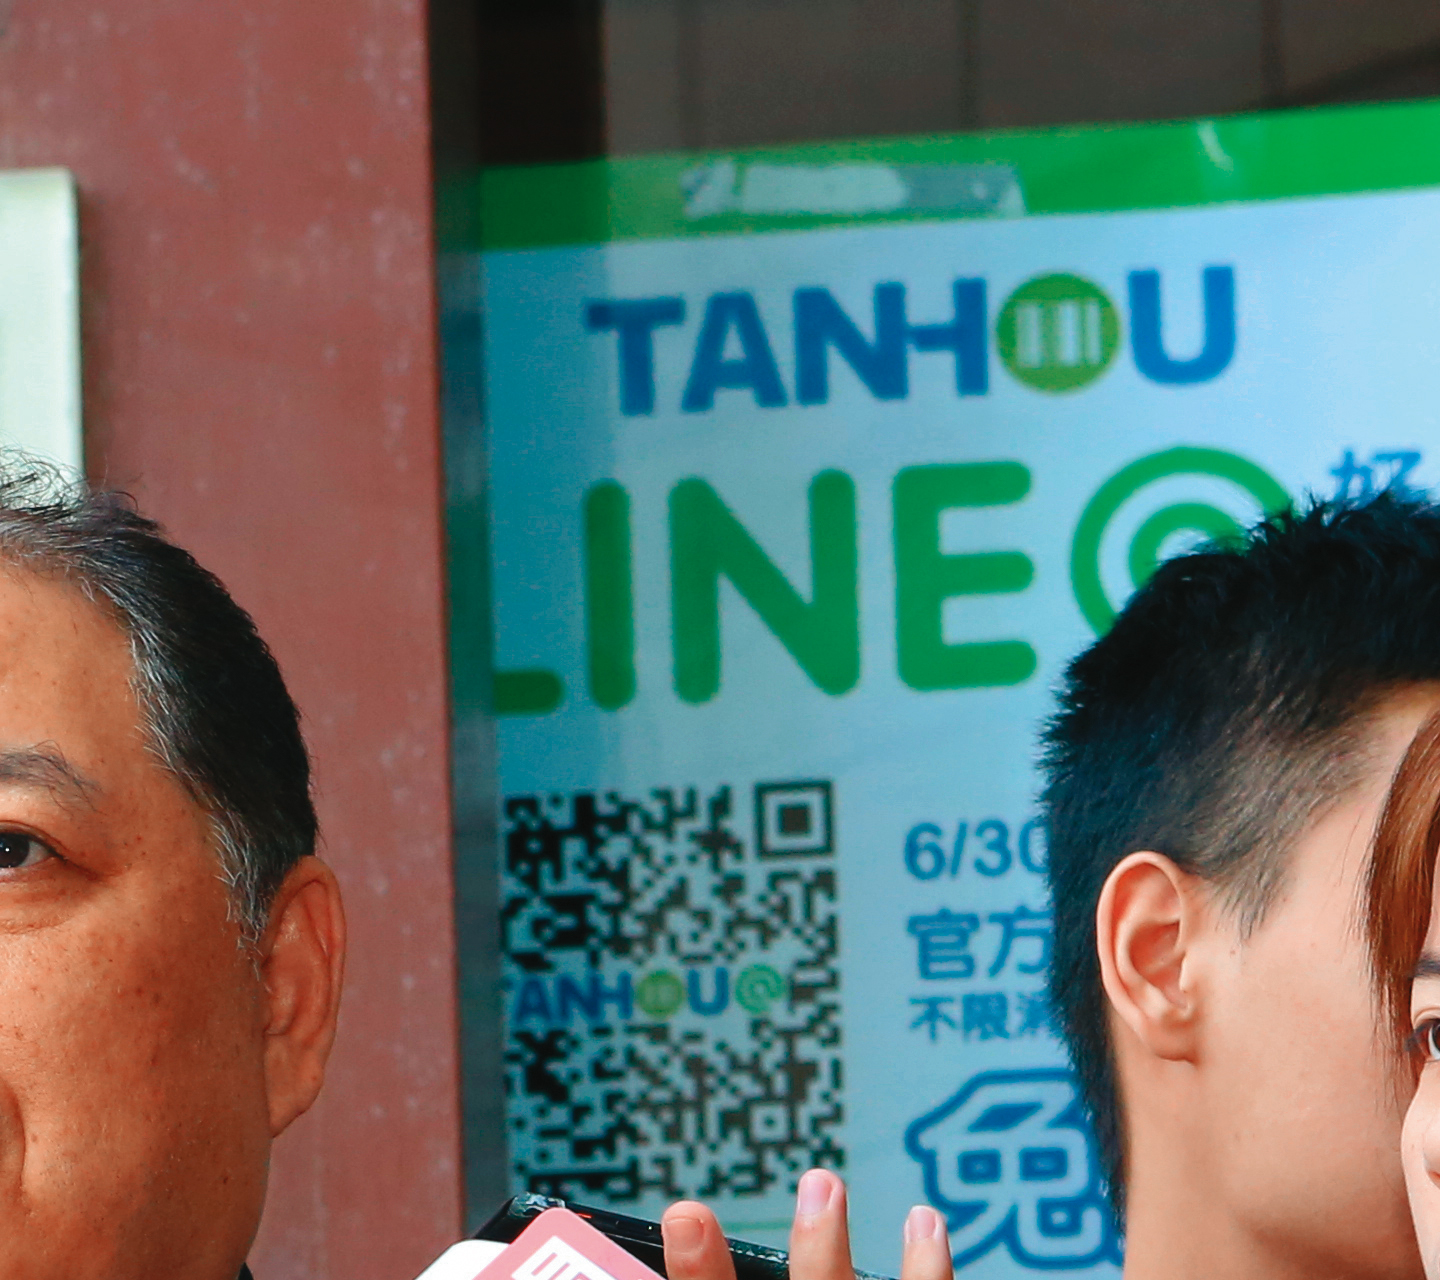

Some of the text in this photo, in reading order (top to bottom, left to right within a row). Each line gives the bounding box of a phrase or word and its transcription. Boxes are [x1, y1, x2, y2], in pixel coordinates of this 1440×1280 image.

[584, 262, 1240, 418] TANHOU
[906, 907, 1057, 982] 官方
[496, 962, 786, 1025] ANHOU@
